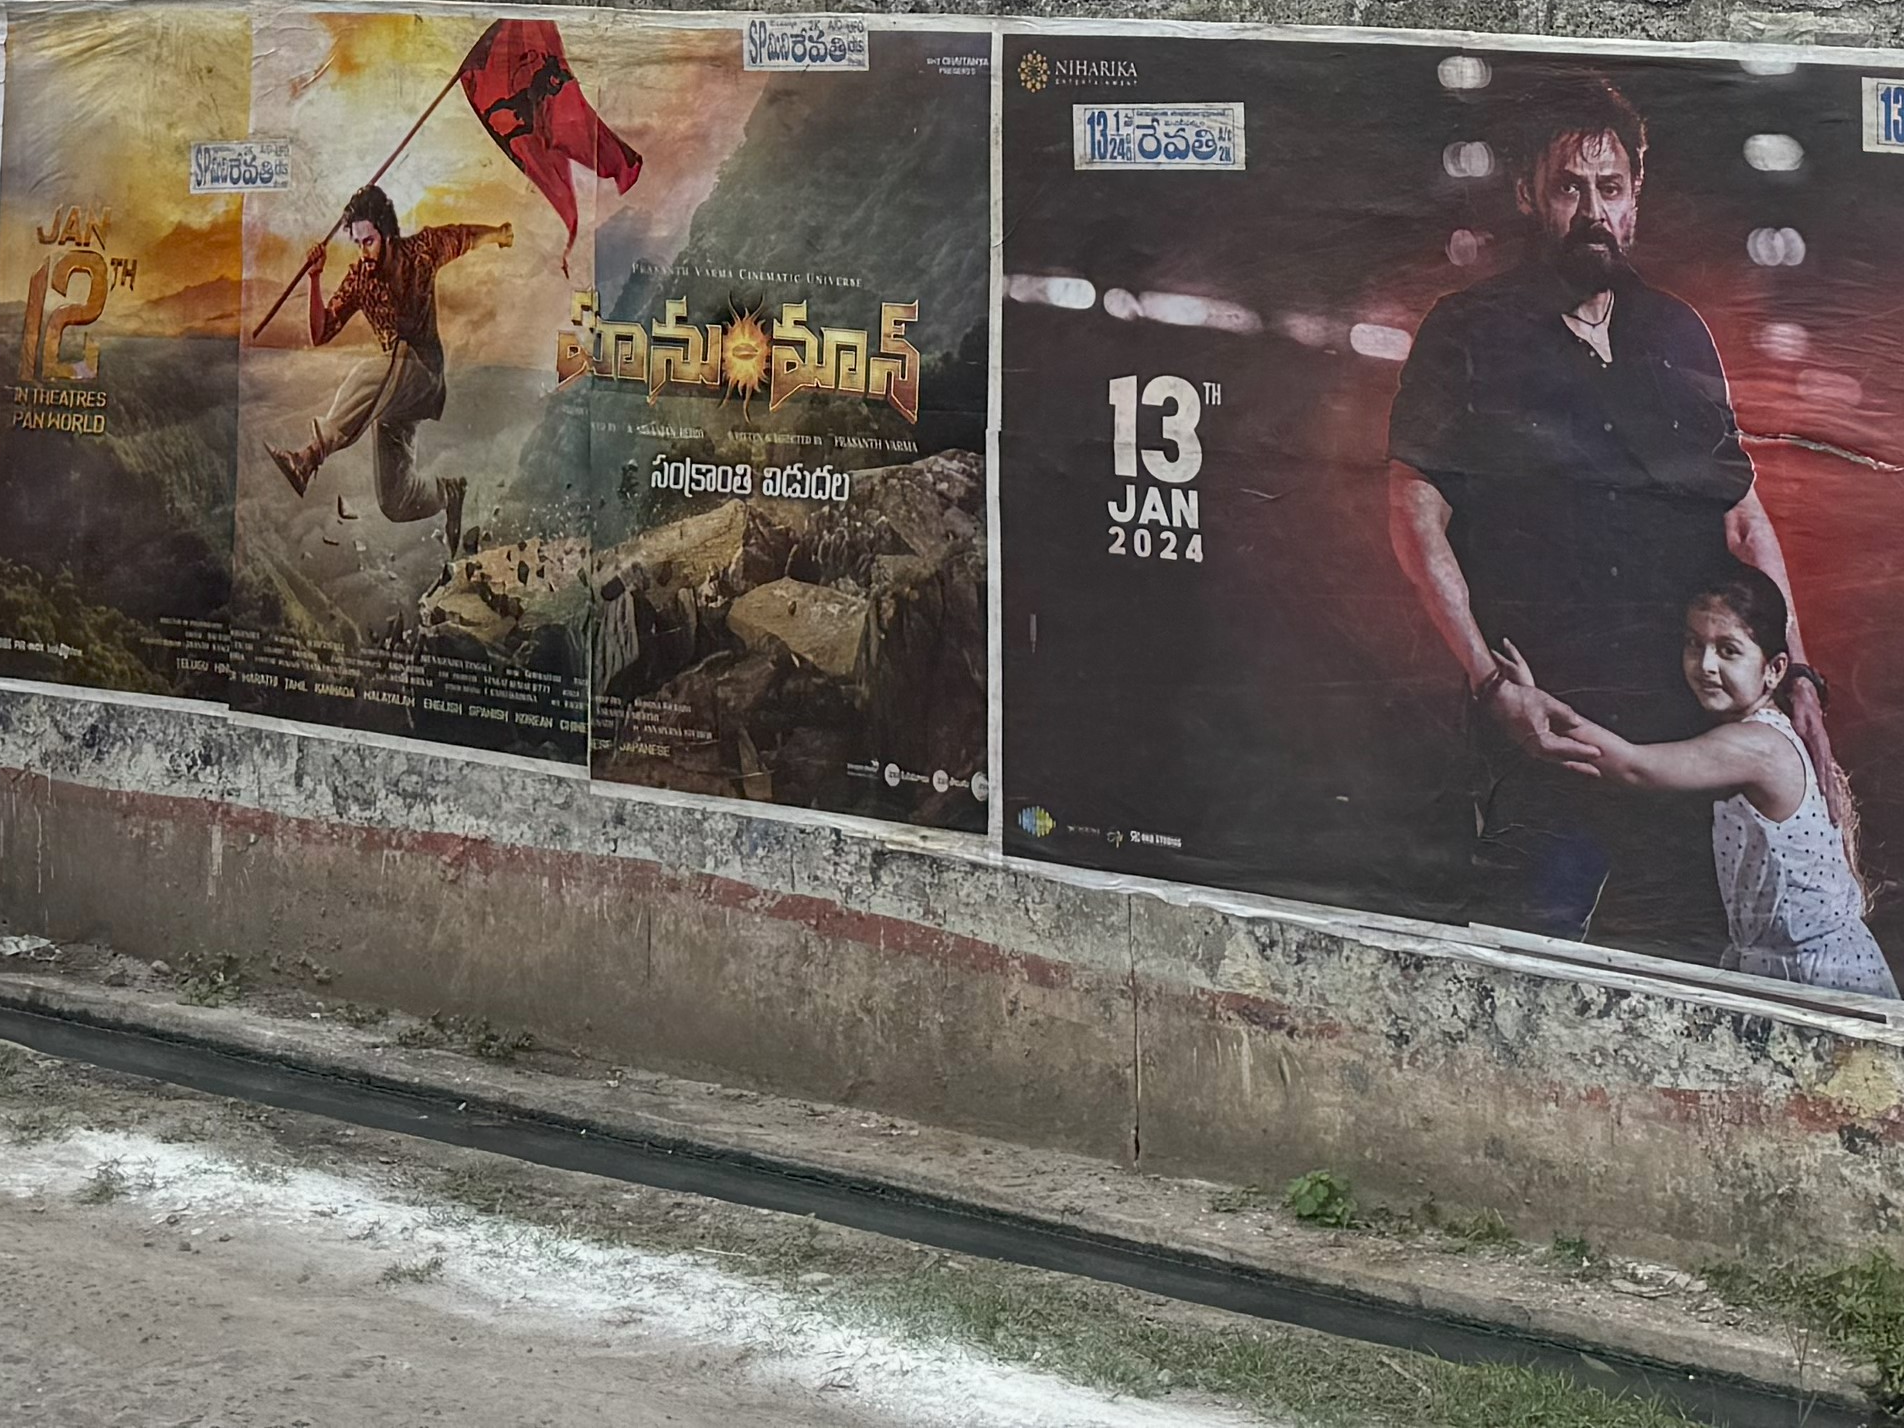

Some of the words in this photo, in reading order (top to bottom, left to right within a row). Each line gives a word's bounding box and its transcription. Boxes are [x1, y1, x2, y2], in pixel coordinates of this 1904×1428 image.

[749, 20, 767, 64] SP
[790, 27, 847, 63] రేవతి
[1055, 60, 1138, 77] NIHARIKA
[1087, 110, 1109, 161] 13
[1109, 137, 1125, 161] 24
[1135, 117, 1218, 161] రేవతి
[37, 204, 111, 250] JAN
[695, 265, 734, 278] VARMA
[739, 268, 800, 283] CINEMATIC
[806, 272, 864, 288] UNIVERSE
[18, 249, 108, 382] 12
[110, 257, 138, 291] TH
[14, 387, 28, 403] IN
[32, 388, 107, 407] THEATRES
[13, 411, 45, 430] PAN
[47, 414, 105, 434] WORLD
[1108, 375, 1203, 483] 13
[1202, 381, 1222, 406] TH
[651, 454, 752, 498] సంక్రాంతి
[762, 462, 851, 502] విడుదల
[1107, 484, 1199, 529] JAN
[1108, 525, 1204, 563] 2024
[176, 657, 209, 672] TELUGU
[315, 682, 356, 698] KANNADA
[364, 689, 416, 707] MALAYALAM
[423, 697, 462, 716] ENGLISH
[469, 705, 509, 723] SPANISH
[514, 712, 554, 729] KOREAN
[619, 741, 671, 757] JAPANESE
